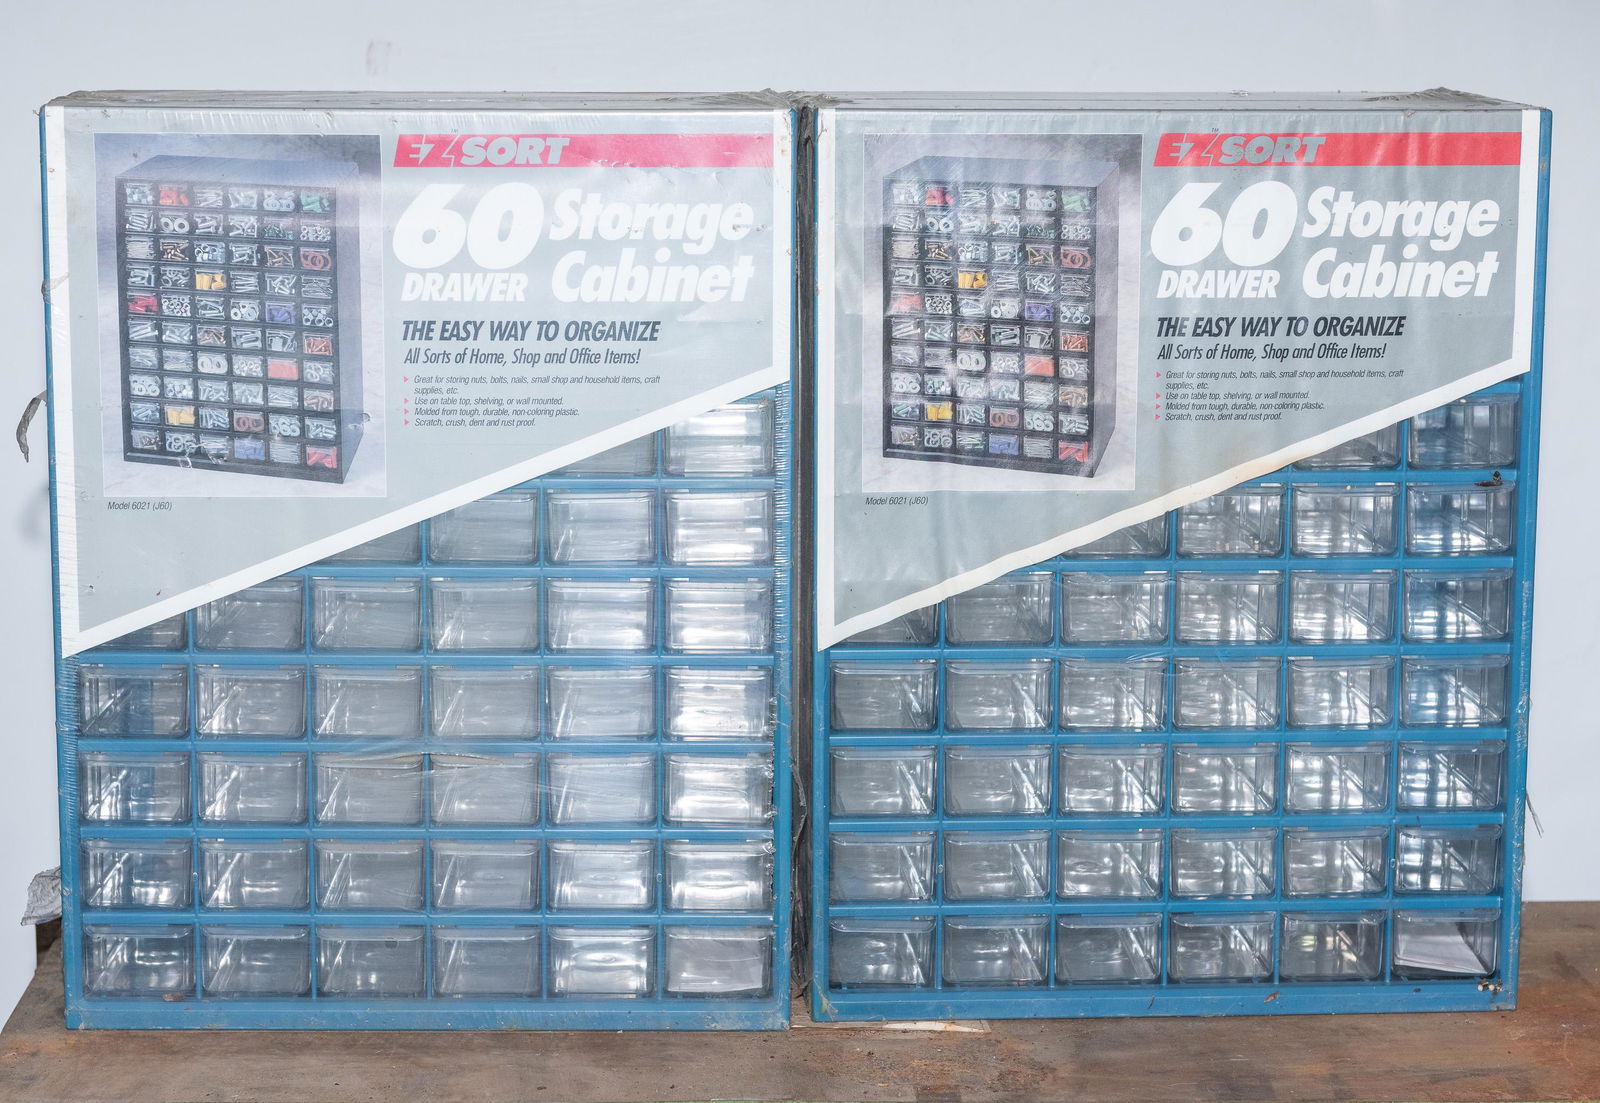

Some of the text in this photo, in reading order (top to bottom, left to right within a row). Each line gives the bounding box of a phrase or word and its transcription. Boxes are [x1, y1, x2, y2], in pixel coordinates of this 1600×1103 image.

[460, 137, 570, 165] SORT
[1219, 135, 1326, 164] SORT
[392, 182, 544, 270] 60
[549, 188, 754, 254] Storage
[1150, 181, 1298, 267] 60
[1301, 186, 1500, 252] Storage
[551, 247, 755, 302] Cabinet
[1302, 244, 1500, 298] Cabinet
[401, 272, 528, 301] DRAWER
[1156, 270, 1280, 298] DRAWER
[402, 320, 661, 341] THE EASY WAY TO ORGANIZE
[1156, 316, 1406, 337] THE EASY WAY TO ORGANIZE
[404, 348, 641, 367] All Sorts of Home, Shop and Office Items!
[1157, 343, 1387, 362] All Sorts of Home, Shop and Office Items!
[414, 375, 660, 385] Great for storing nuts, bolts, nails, small shop and household items, craft
[1166, 370, 1404, 380] Great for storing nuts, bolts, nails, small shop and household items, craft
[414, 386, 443, 396] supplies,
[1166, 382, 1209, 391] supplies, etc.
[414, 397, 564, 406] Use on table top, shelving, or wall mounted.
[1166, 392, 1309, 401] Use on table top, shelving, or wall mounted.
[414, 408, 579, 417] Molded from tough, durable, non-coloring plastic.
[1166, 402, 1324, 412] Molded from tough, durable, non-coloring plastic.
[414, 418, 535, 428] Scratch, crush, dent and rust proof.
[1165, 413, 1282, 421] Scratch, crush, dent and rust proof.
[108, 501, 172, 511] Model 6021 (J60)
[865, 496, 928, 506] Model 6021 (J60)
